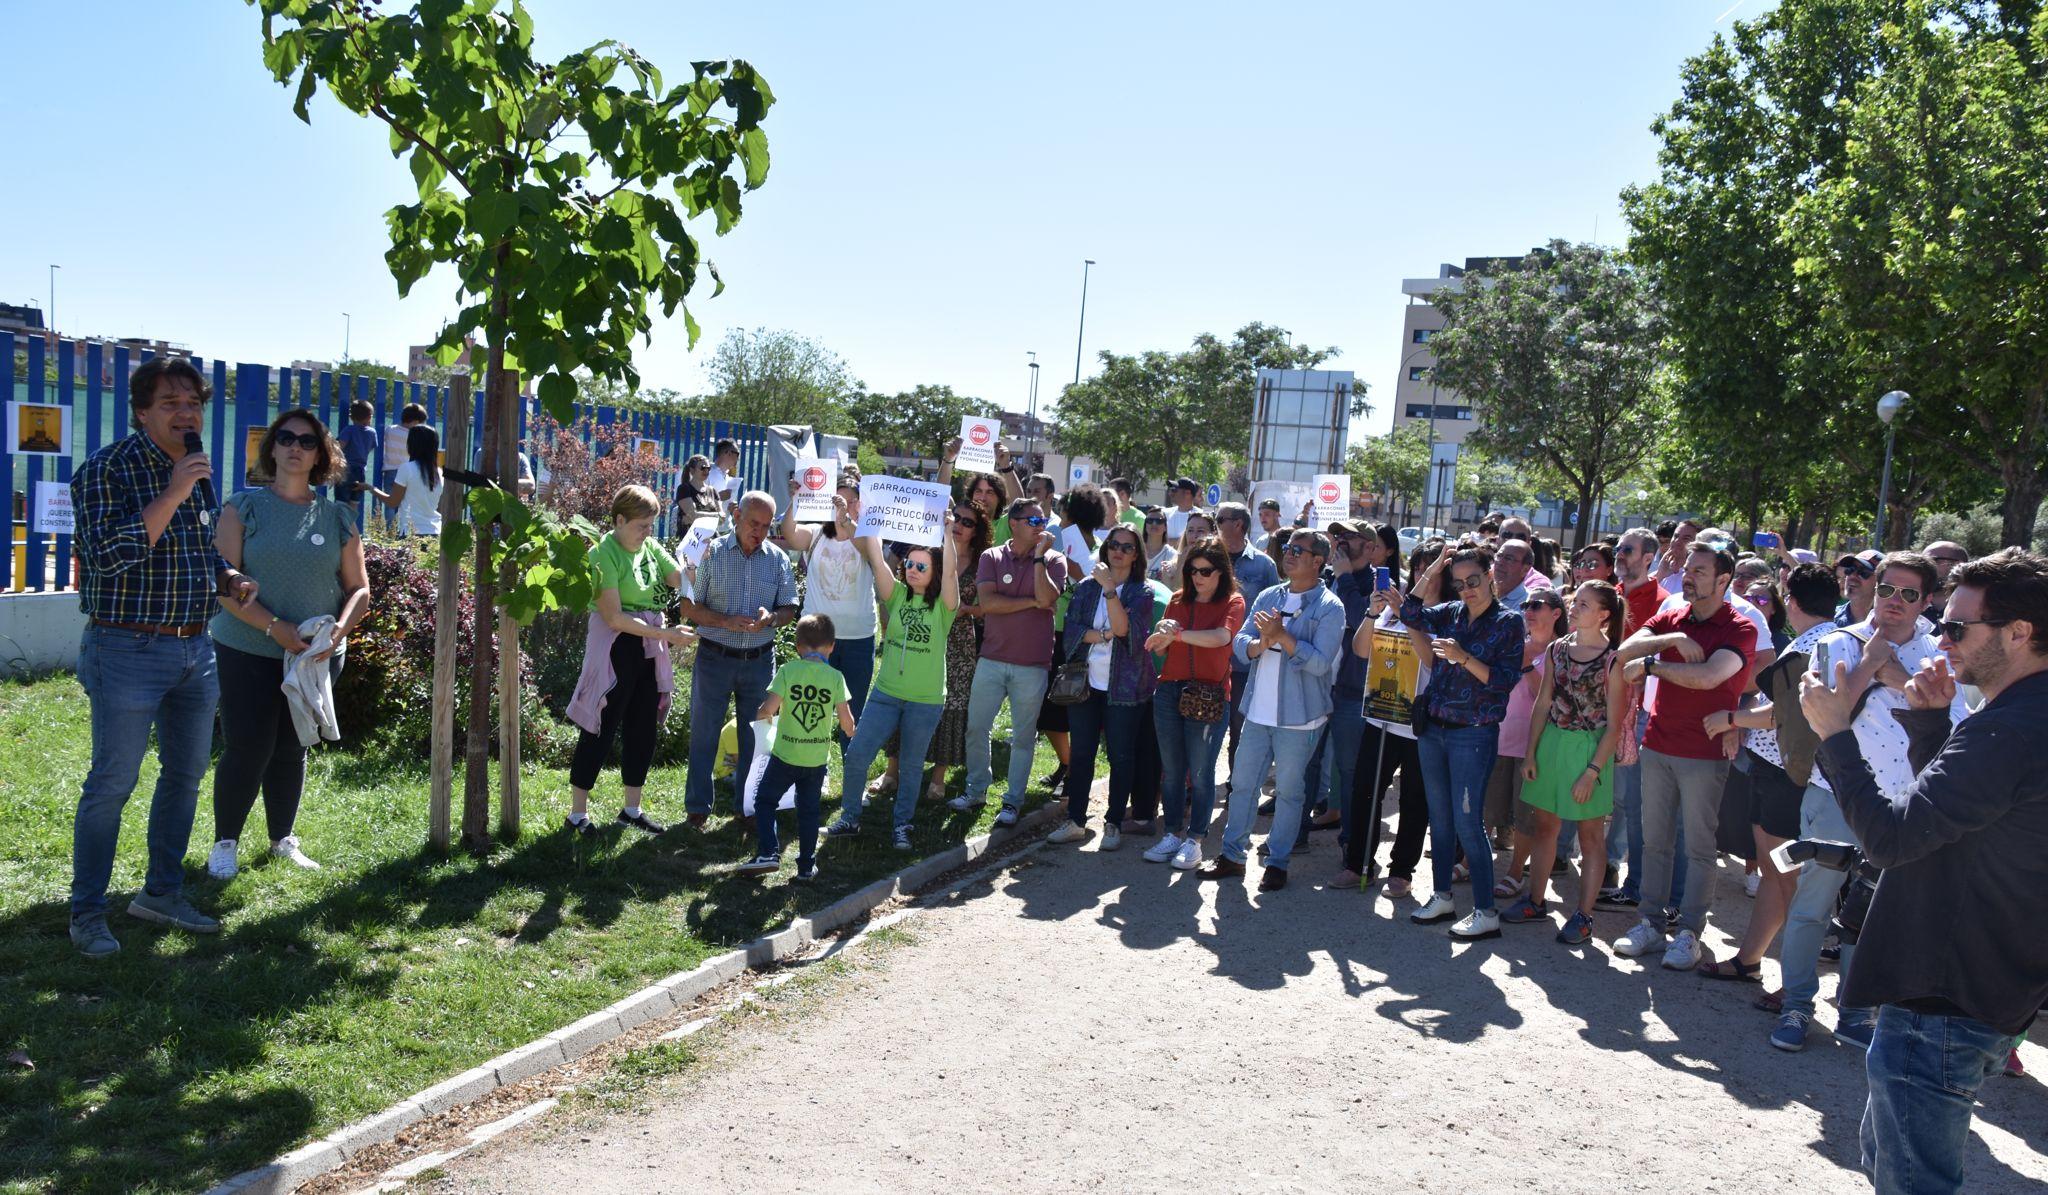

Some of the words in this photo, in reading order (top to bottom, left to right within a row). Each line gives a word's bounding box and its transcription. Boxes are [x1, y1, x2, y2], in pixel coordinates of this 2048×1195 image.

[971, 431, 988, 439] STOP
[806, 475, 824, 483] STOP
[870, 482, 938, 498] ¡BARRACONES
[1320, 489, 1338, 497] STOP
[47, 498, 72, 506] BARRA
[893, 495, 911, 505] NO!
[47, 510, 74, 518] ¡QUERE
[865, 505, 939, 523] ¡CONSTRUCCIÓN
[40, 519, 75, 527] CONSTRUC
[865, 517, 914, 532] COMPLETA
[917, 525, 932, 535] YA!
[906, 632, 931, 644] SOS
[789, 684, 832, 704] SOS
[1380, 691, 1396, 700] SOS
